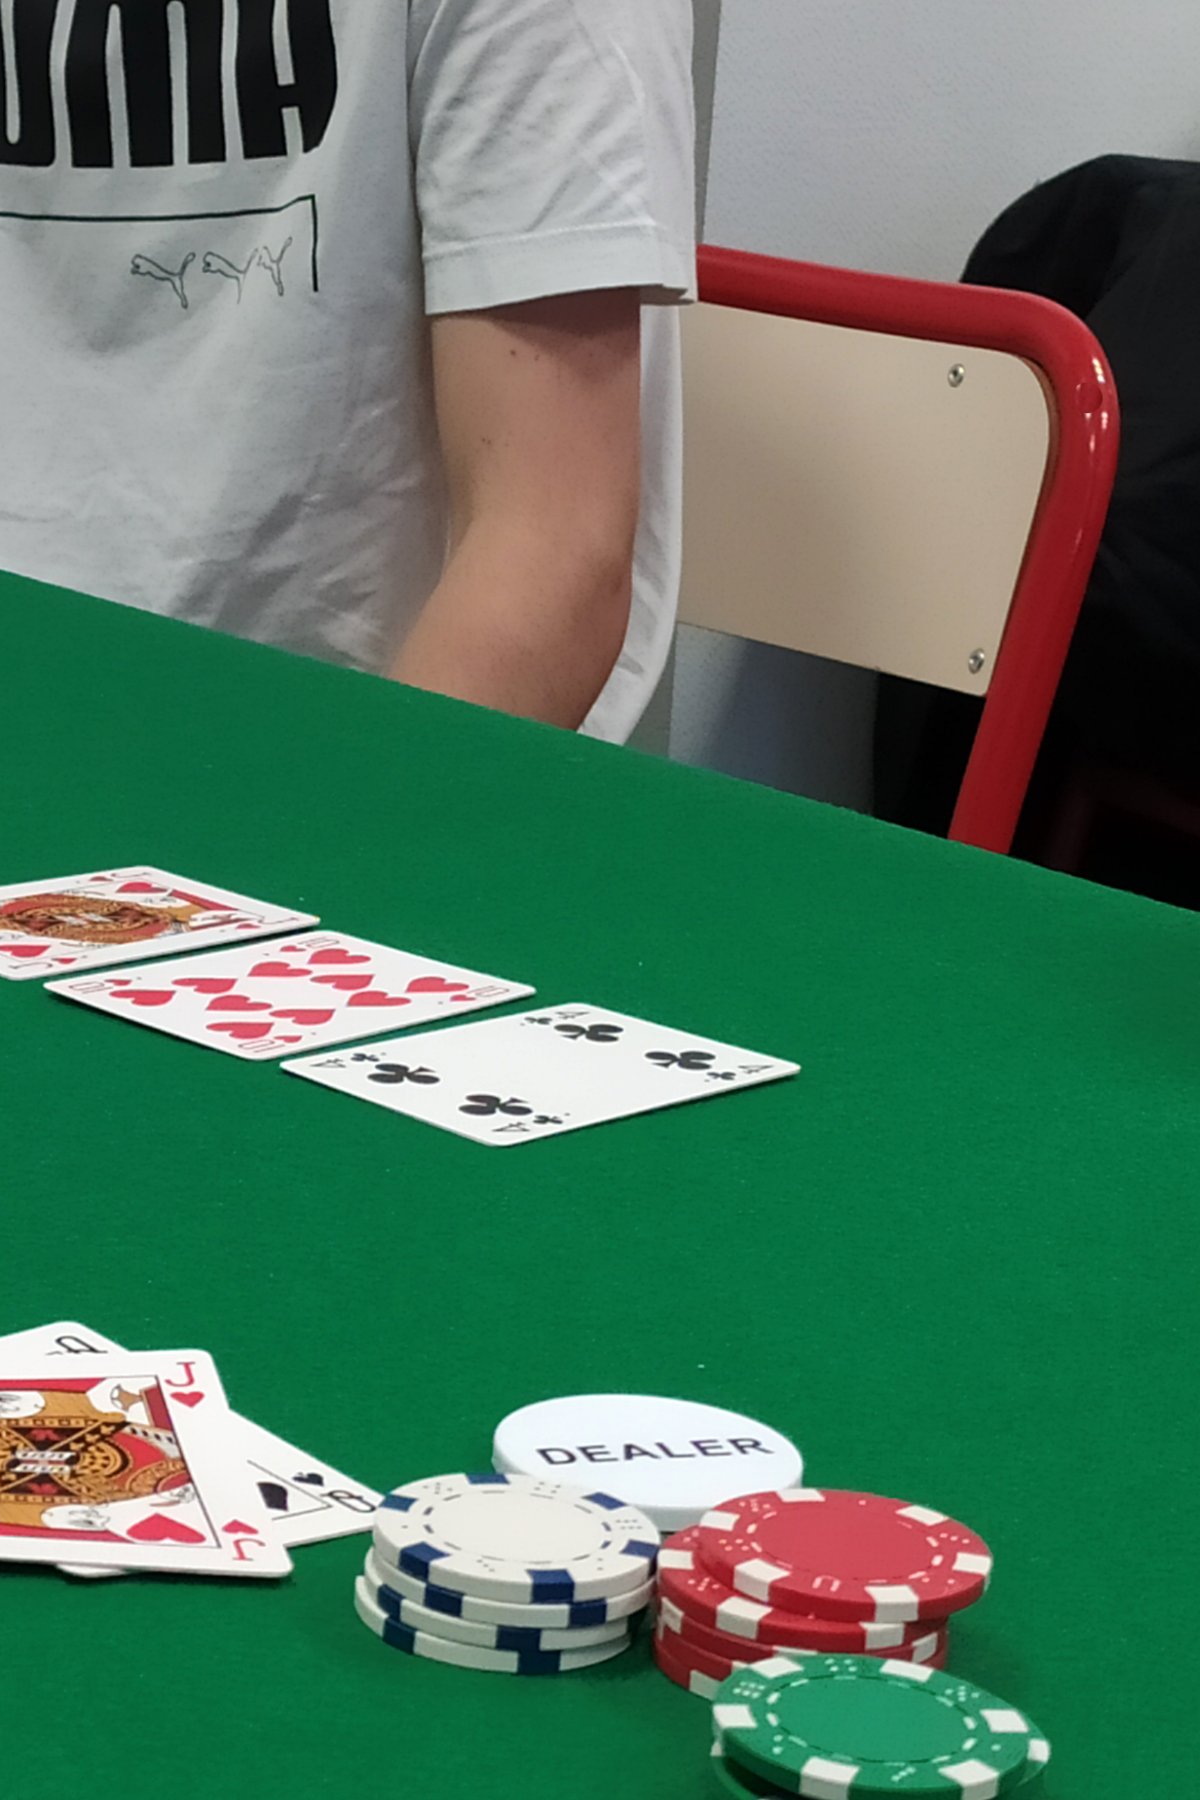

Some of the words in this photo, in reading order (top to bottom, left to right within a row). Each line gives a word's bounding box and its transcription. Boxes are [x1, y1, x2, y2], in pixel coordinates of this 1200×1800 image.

[164, 1361, 197, 1388] J
[536, 1437, 776, 1466] DEALER
[232, 1537, 267, 1562] J
